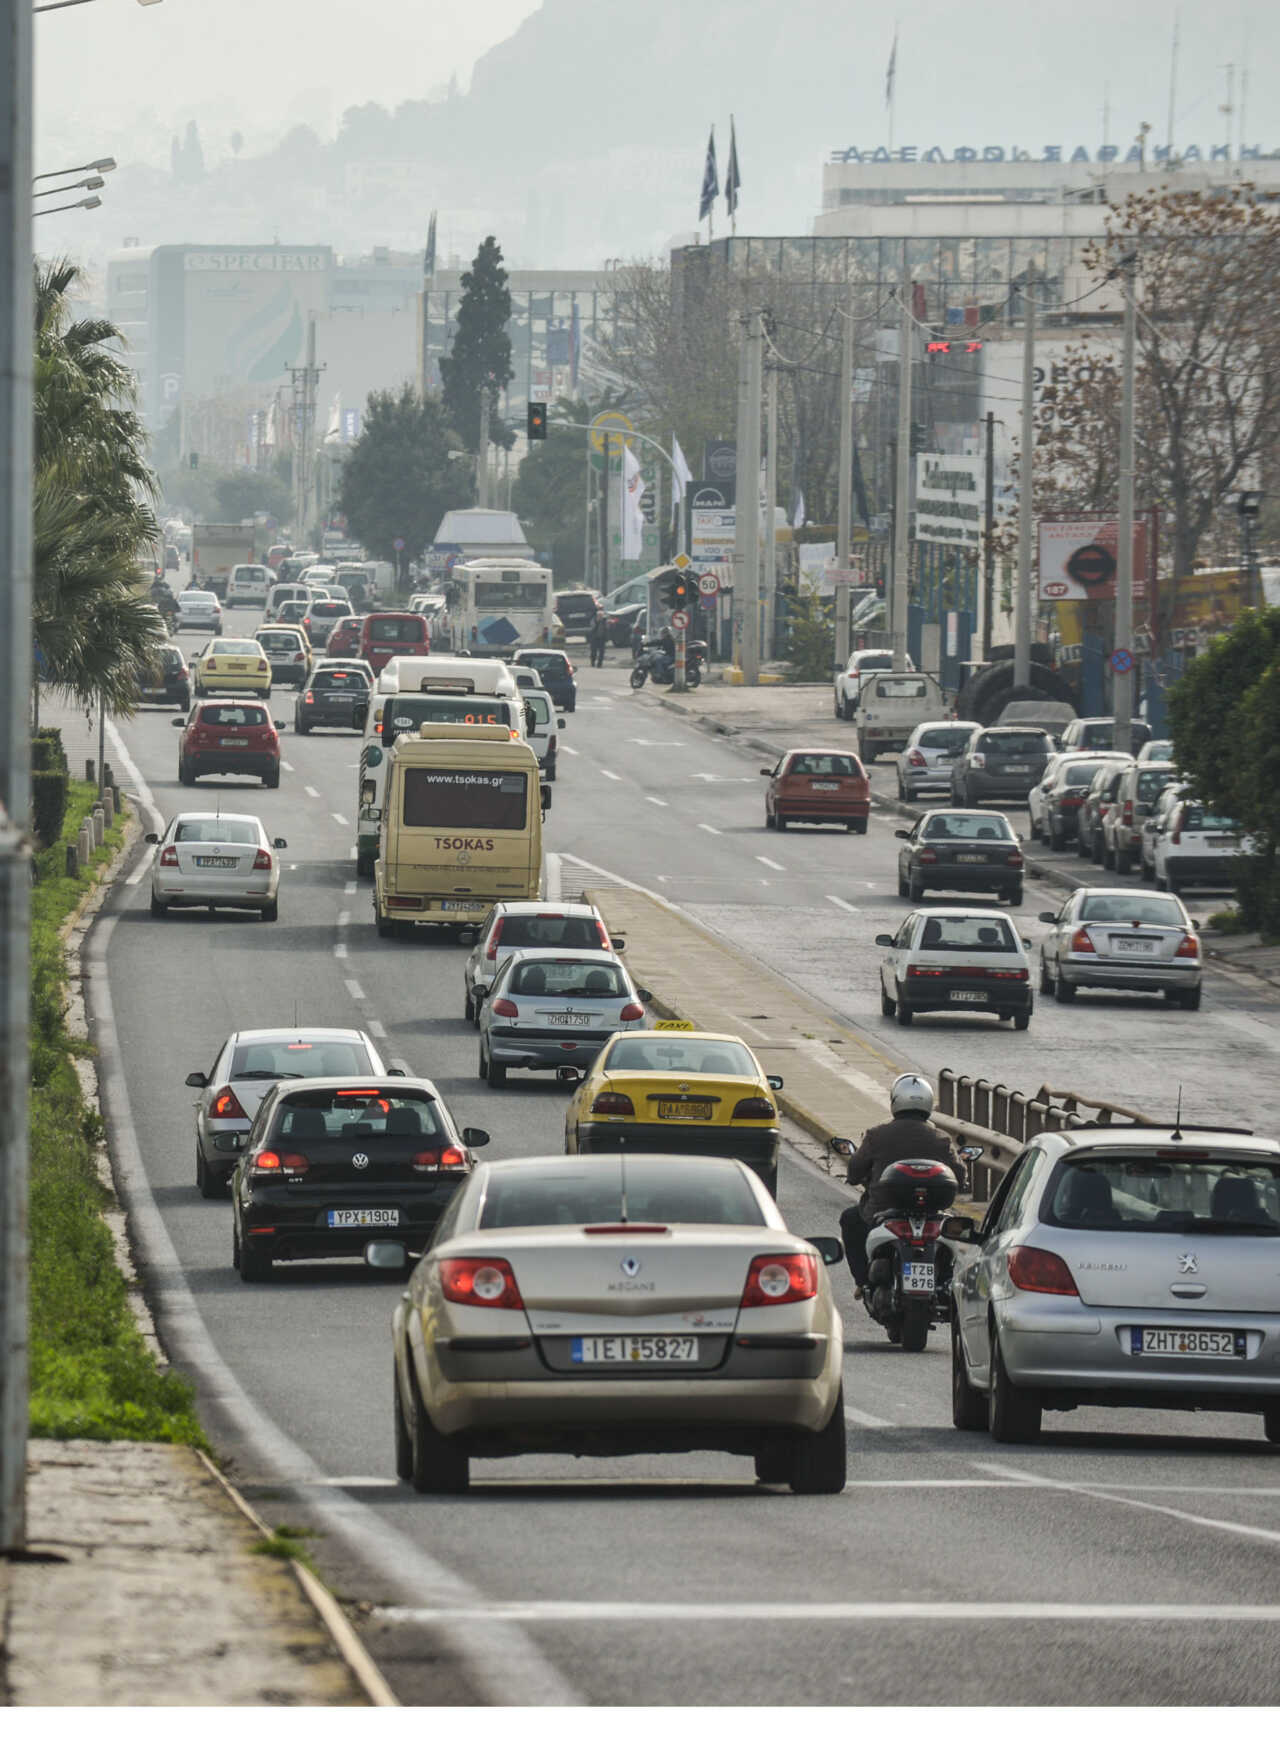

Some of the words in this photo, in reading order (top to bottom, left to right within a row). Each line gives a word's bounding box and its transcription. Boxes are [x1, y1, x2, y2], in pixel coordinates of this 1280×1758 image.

[702, 579, 716, 590] 50
[426, 775, 503, 787] www.tsokas.gr
[434, 837, 494, 851] TSOKAS
[911, 1278, 934, 1289] 876
